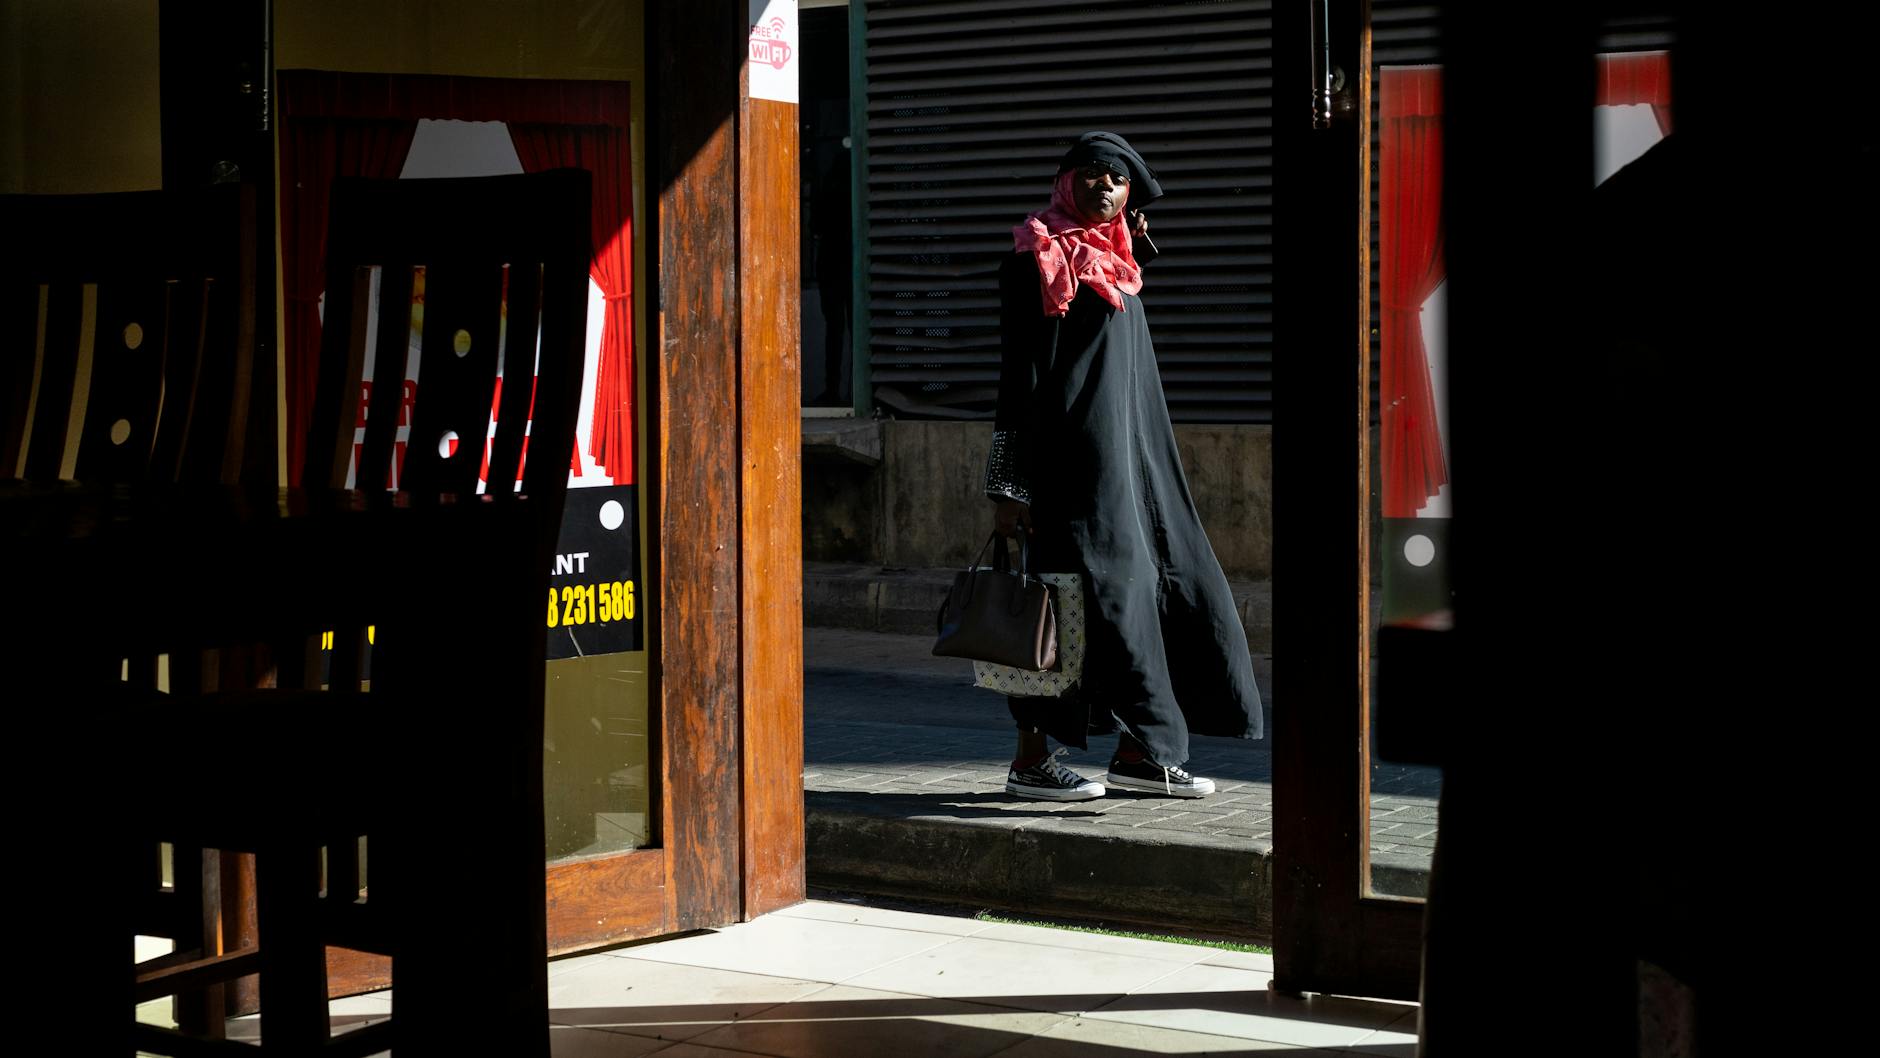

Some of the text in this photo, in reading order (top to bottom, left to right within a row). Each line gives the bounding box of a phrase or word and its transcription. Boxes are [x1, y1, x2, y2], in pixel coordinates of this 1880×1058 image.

[750, 24, 772, 38] FREE
[551, 551, 590, 576] NT
[561, 583, 597, 627] 231
[598, 579, 636, 623] 586
